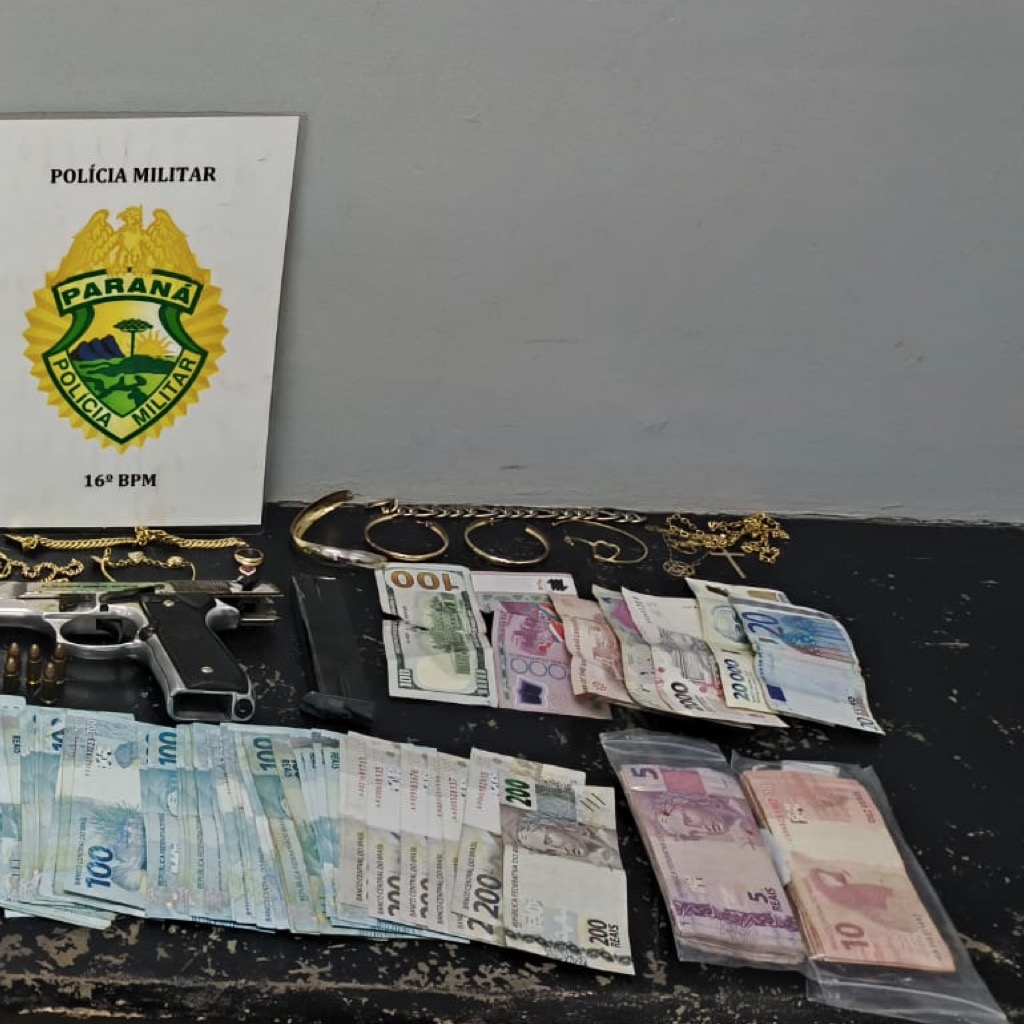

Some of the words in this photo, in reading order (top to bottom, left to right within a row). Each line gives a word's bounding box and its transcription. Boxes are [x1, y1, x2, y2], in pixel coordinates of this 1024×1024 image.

[50, 163, 127, 184] POLÍCIA
[133, 166, 216, 183] MILITAR
[60, 279, 195, 307] PARANÁ
[51, 357, 113, 428] POLÍCIA
[132, 356, 197, 427] MILITAR
[84, 474, 114, 488] 16º
[118, 473, 157, 487] BPM
[391, 571, 459, 591] 100
[741, 611, 784, 637] 20
[159, 732, 176, 765] 100
[253, 736, 277, 771] 100
[505, 778, 531, 807] 200
[86, 845, 114, 889] 100
[474, 873, 502, 920] 200
[747, 890, 769, 903] 5
[587, 919, 609, 947] 200
[607, 924, 621, 948] REAIS
[836, 922, 869, 950] 10
